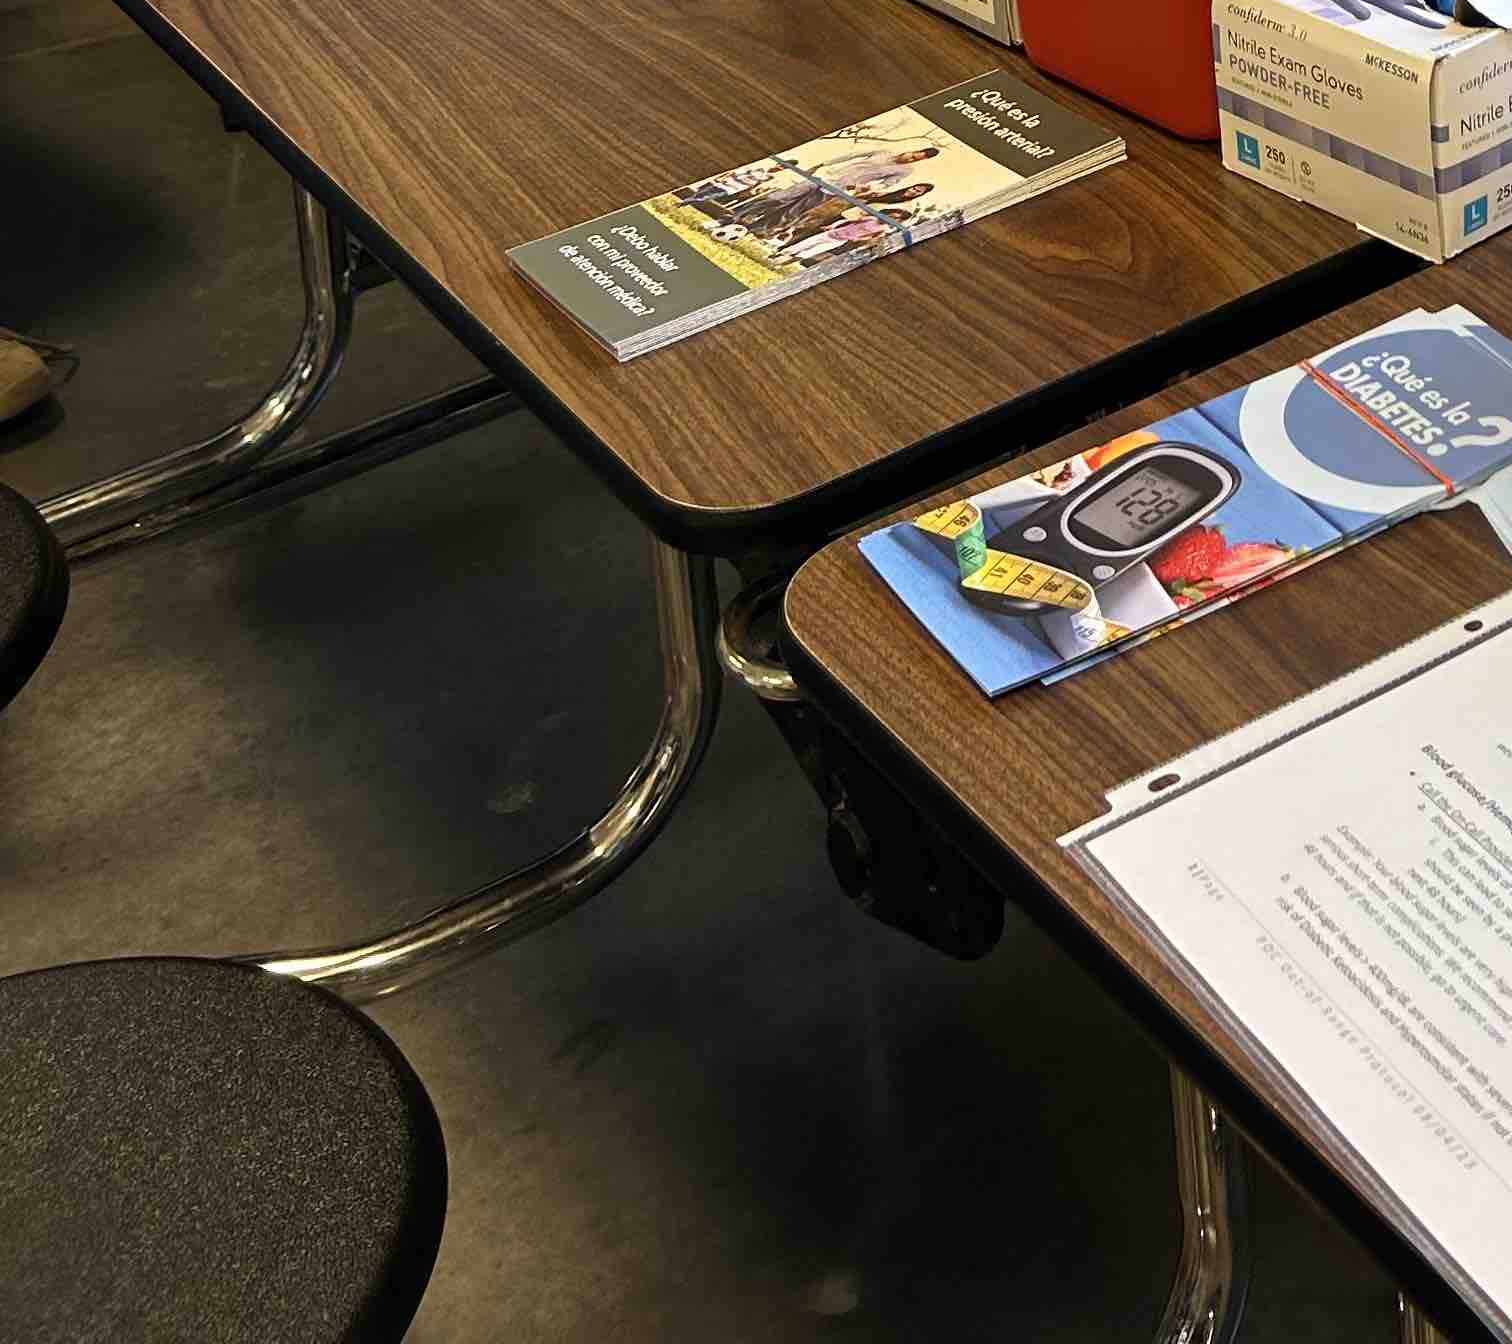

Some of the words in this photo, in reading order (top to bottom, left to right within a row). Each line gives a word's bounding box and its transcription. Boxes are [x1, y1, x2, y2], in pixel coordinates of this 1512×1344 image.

[1227, 29, 1266, 59] Nitrile
[1270, 47, 1308, 77] Exam
[1311, 65, 1364, 101] Gloves
[1228, 54, 1331, 110] POWDER-FREE
[944, 98, 1000, 131] presión
[993, 127, 1056, 159] arterial?
[1007, 108, 1028, 121] es
[1021, 114, 1041, 129] la
[1460, 104, 1504, 136] Nitrile
[1265, 145, 1287, 165] 250
[559, 244, 579, 257] de
[587, 234, 611, 252] con
[642, 245, 680, 272] hablar
[1362, 352, 1433, 392] ¿Qué
[1420, 390, 1449, 410] es
[1442, 401, 1471, 426] la
[1116, 487, 1179, 525] 128
[1417, 743, 1455, 772] Blood
